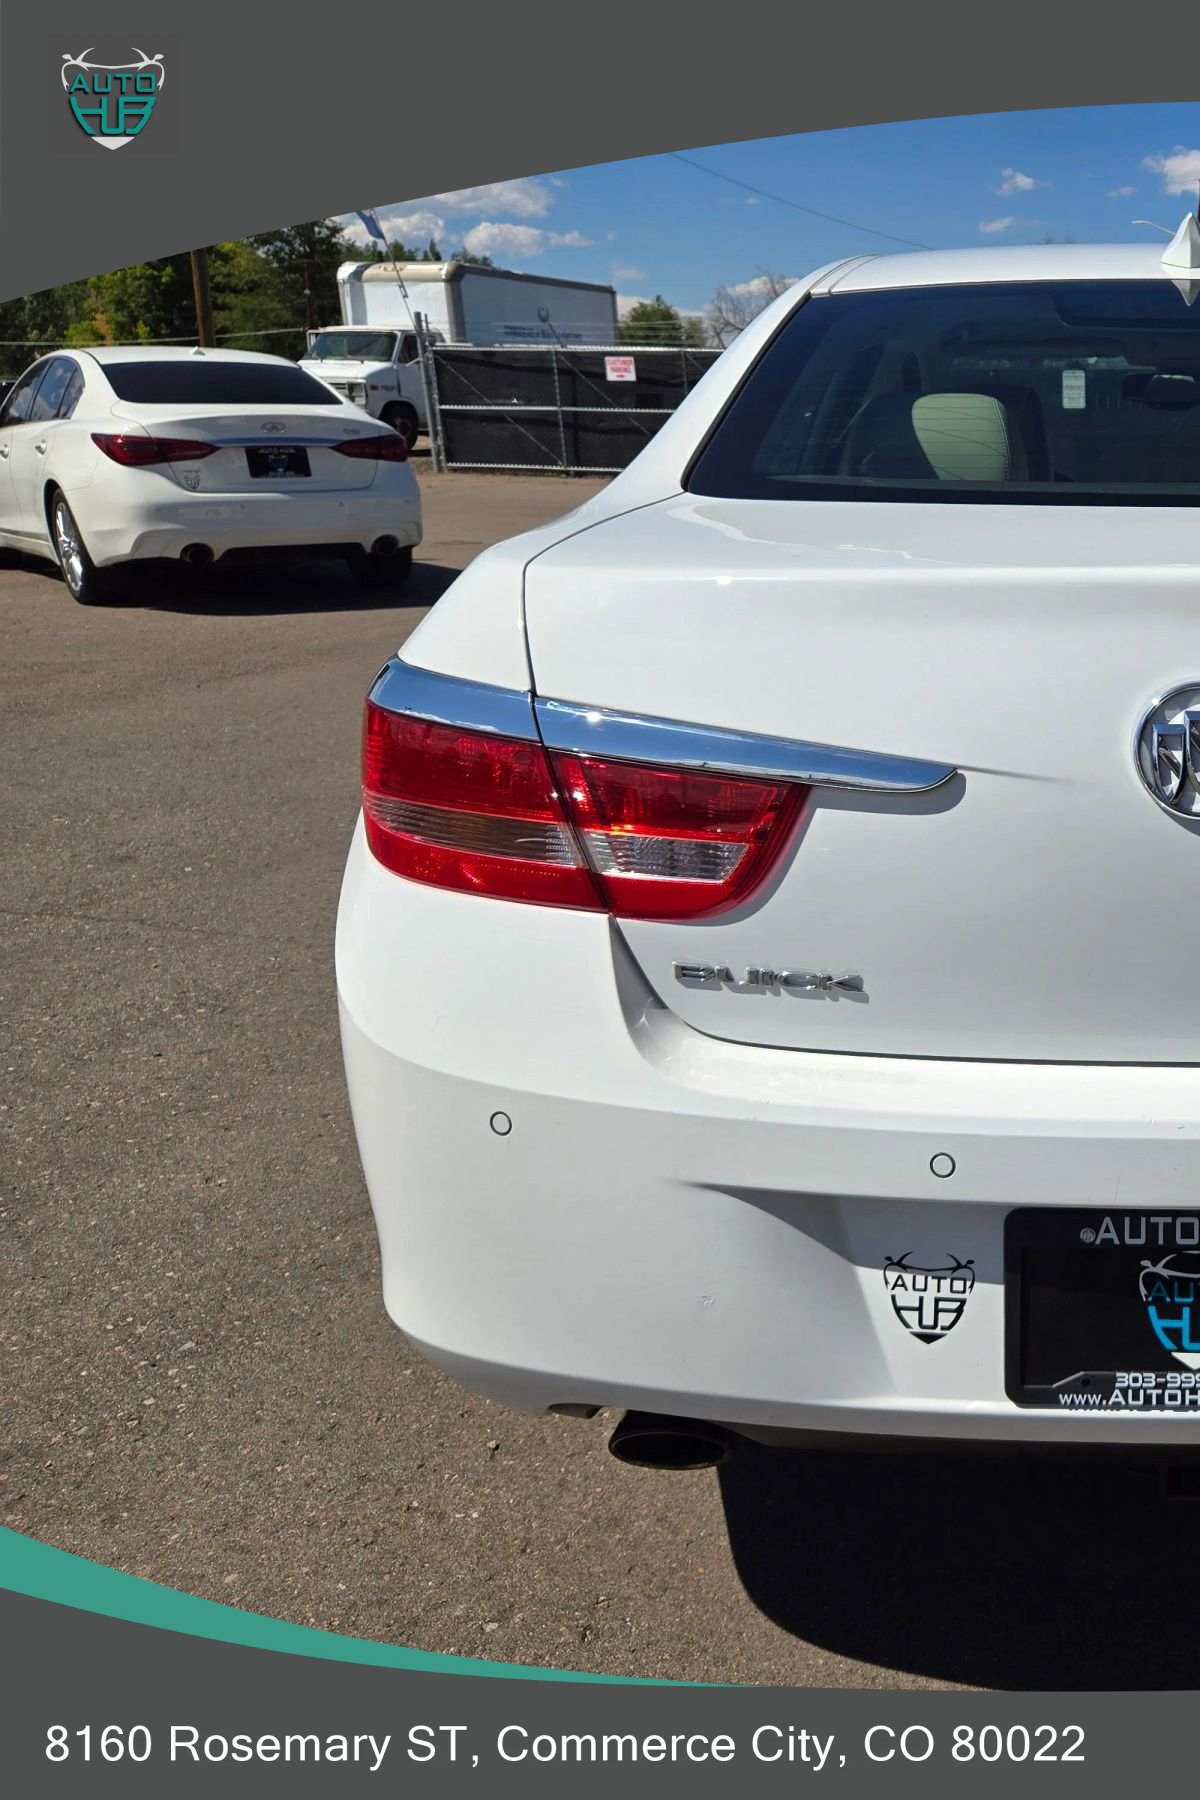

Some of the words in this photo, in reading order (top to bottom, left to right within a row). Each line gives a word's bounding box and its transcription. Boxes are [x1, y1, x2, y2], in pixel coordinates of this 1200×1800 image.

[673, 961, 866, 993] BUICK
[1095, 1216, 1200, 1246] AUTO
[890, 1274, 967, 1295] AUTO
[890, 1294, 968, 1331] HUB
